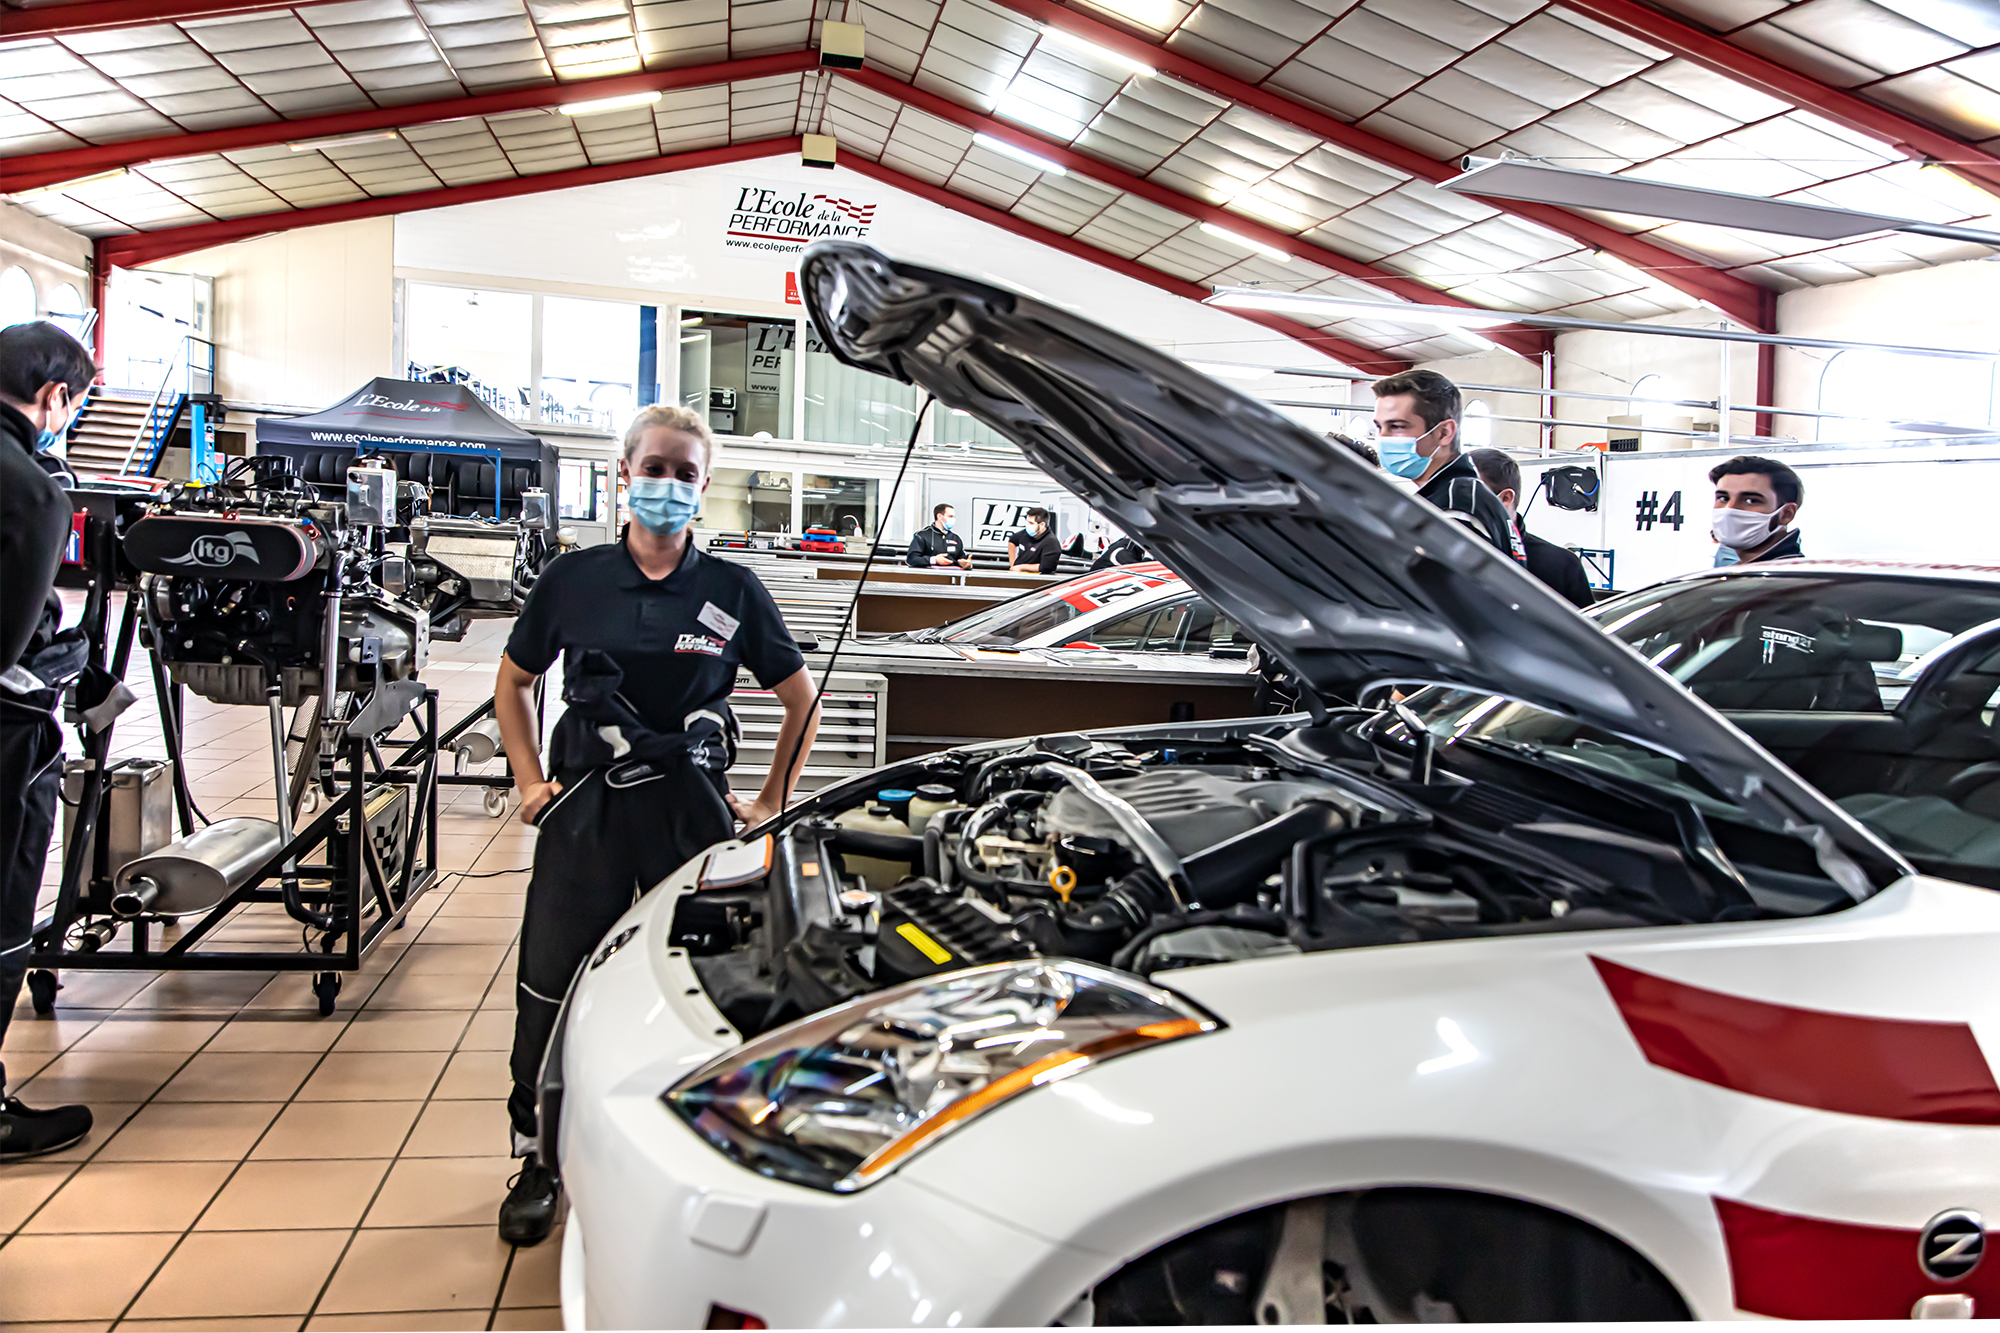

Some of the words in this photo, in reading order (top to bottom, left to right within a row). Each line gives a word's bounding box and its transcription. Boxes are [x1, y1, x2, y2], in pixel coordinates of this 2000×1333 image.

[735, 186, 815, 219] L'Ecole
[817, 209, 830, 221] de
[831, 209, 842, 222] la
[725, 238, 805, 254] www.ecoleperfo
[353, 393, 420, 412] L'Ecole
[1635, 490, 1685, 532] #4
